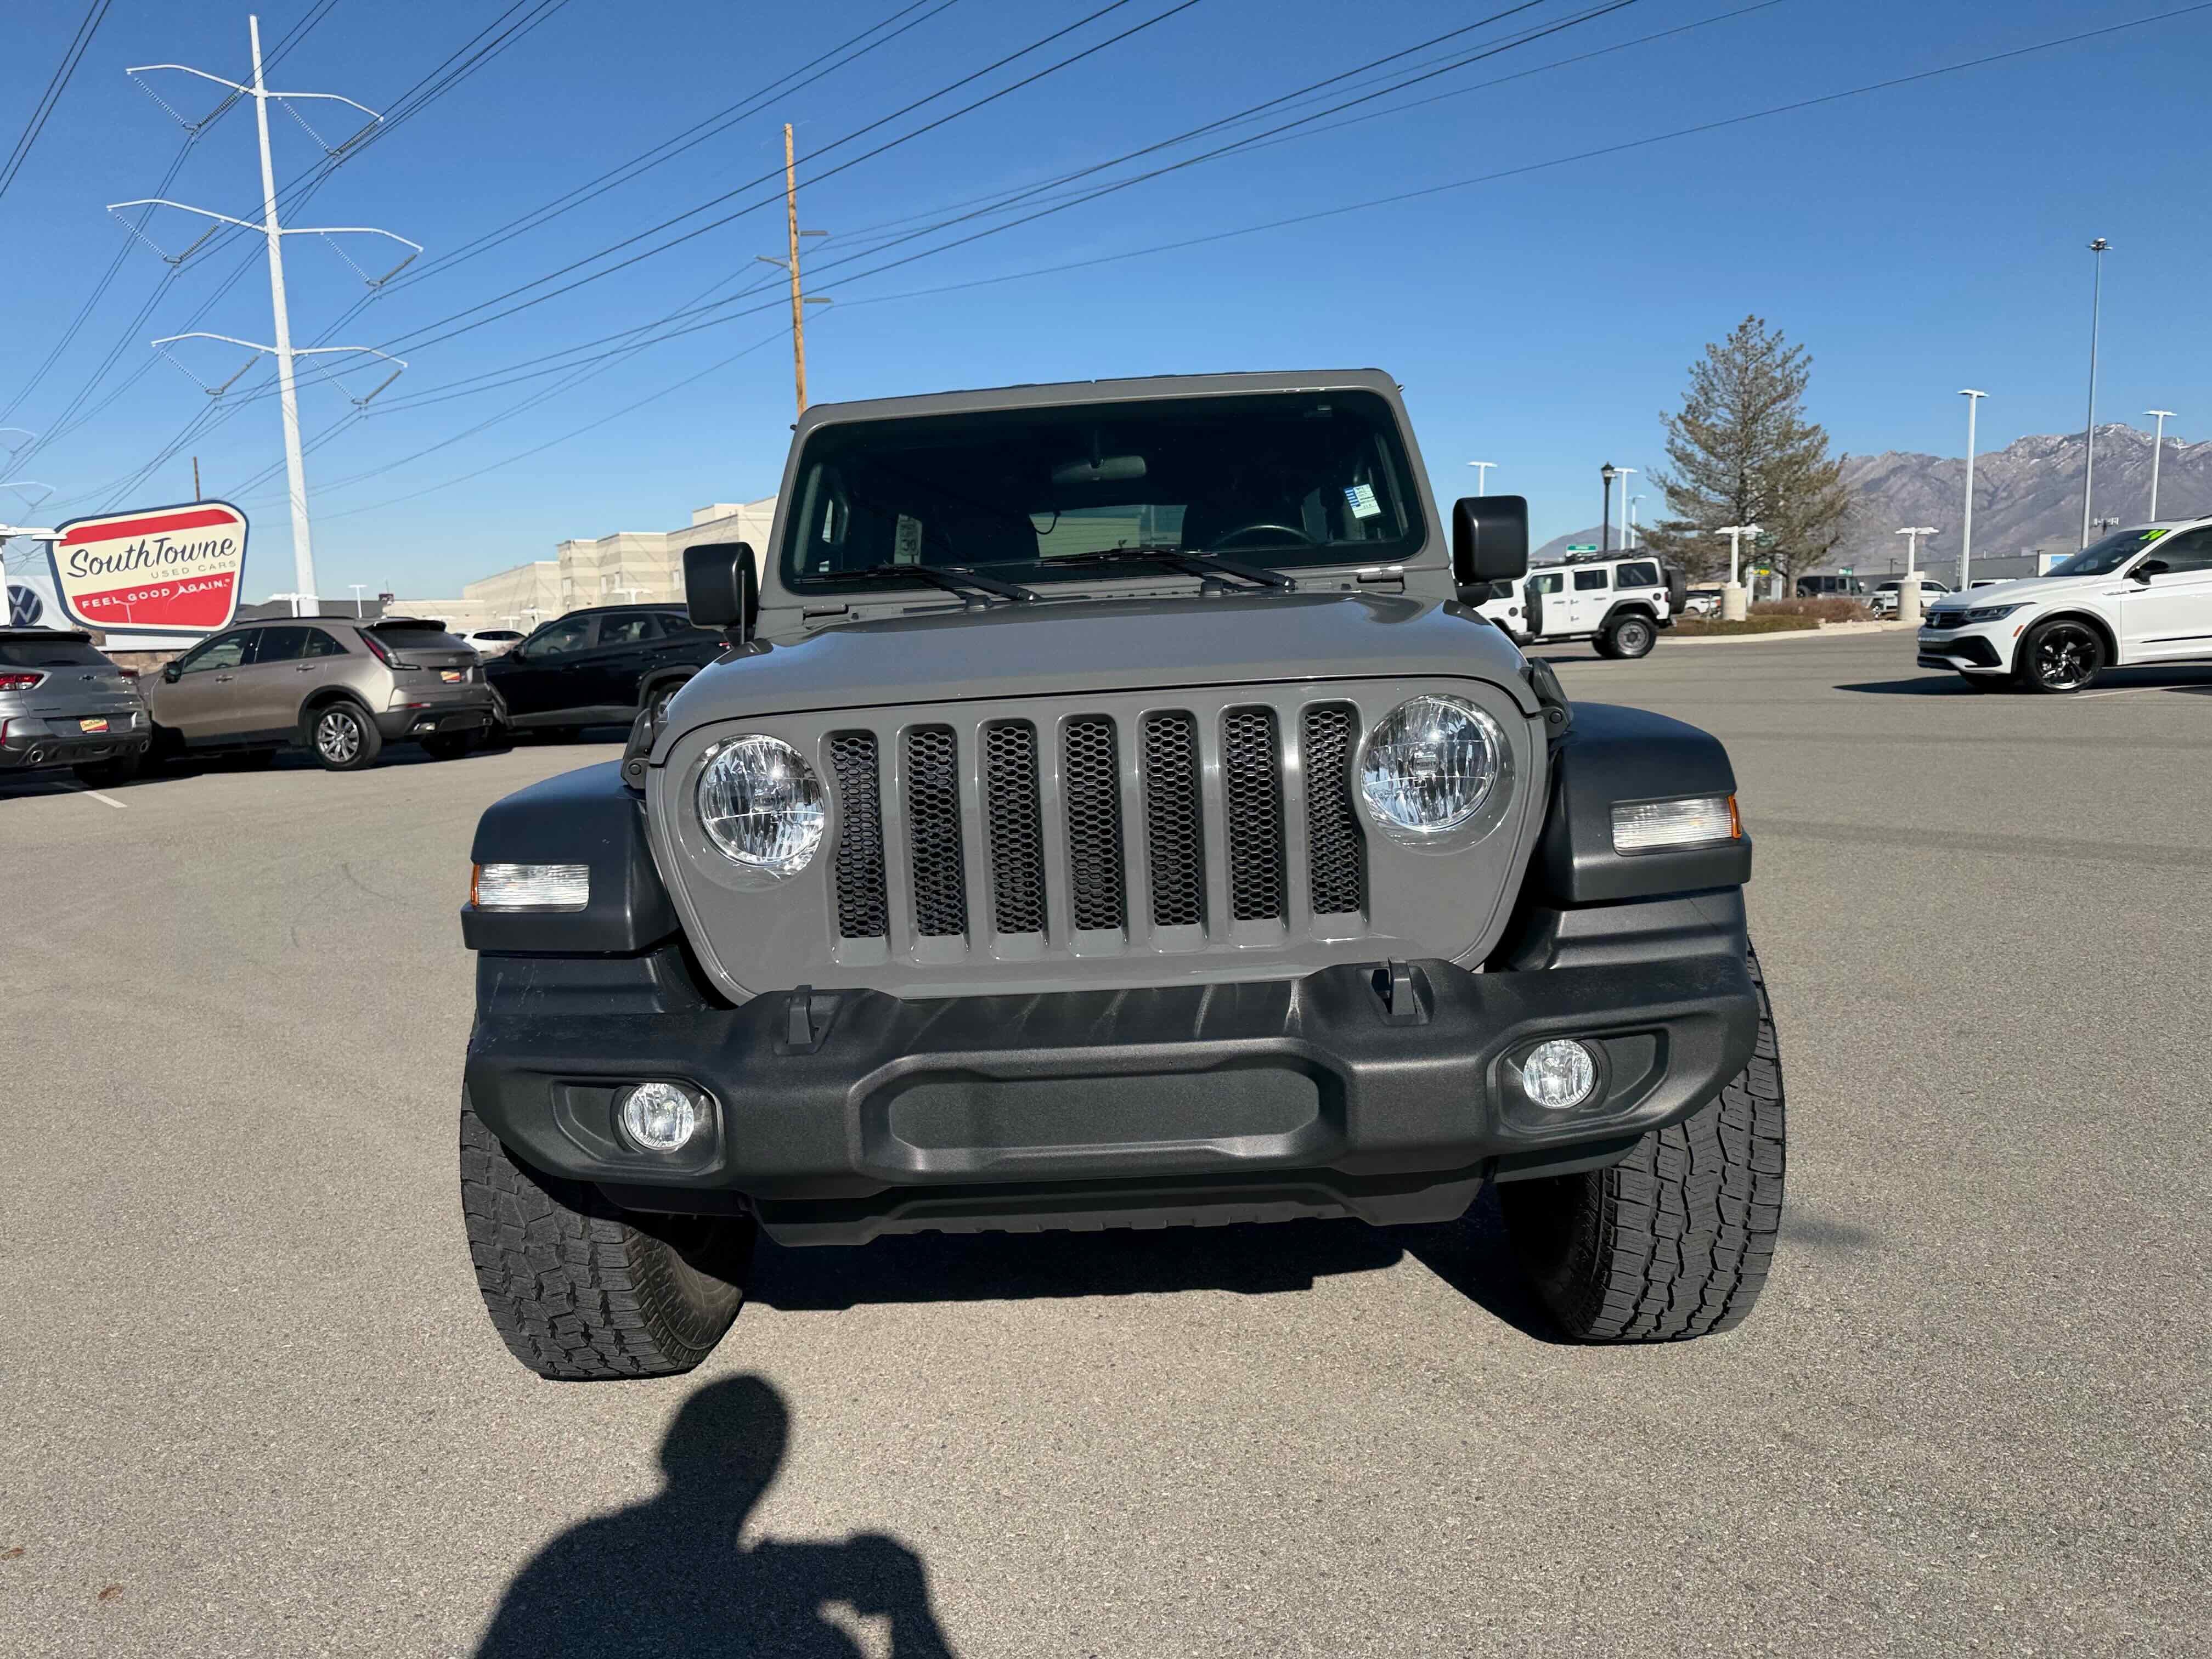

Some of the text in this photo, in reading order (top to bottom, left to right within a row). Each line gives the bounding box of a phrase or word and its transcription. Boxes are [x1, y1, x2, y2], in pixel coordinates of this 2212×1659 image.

[66, 537, 236, 578] SouthTowne
[150, 560, 236, 579] USED CARS
[81, 596, 119, 608] FEEL
[127, 588, 170, 601] GOOD
